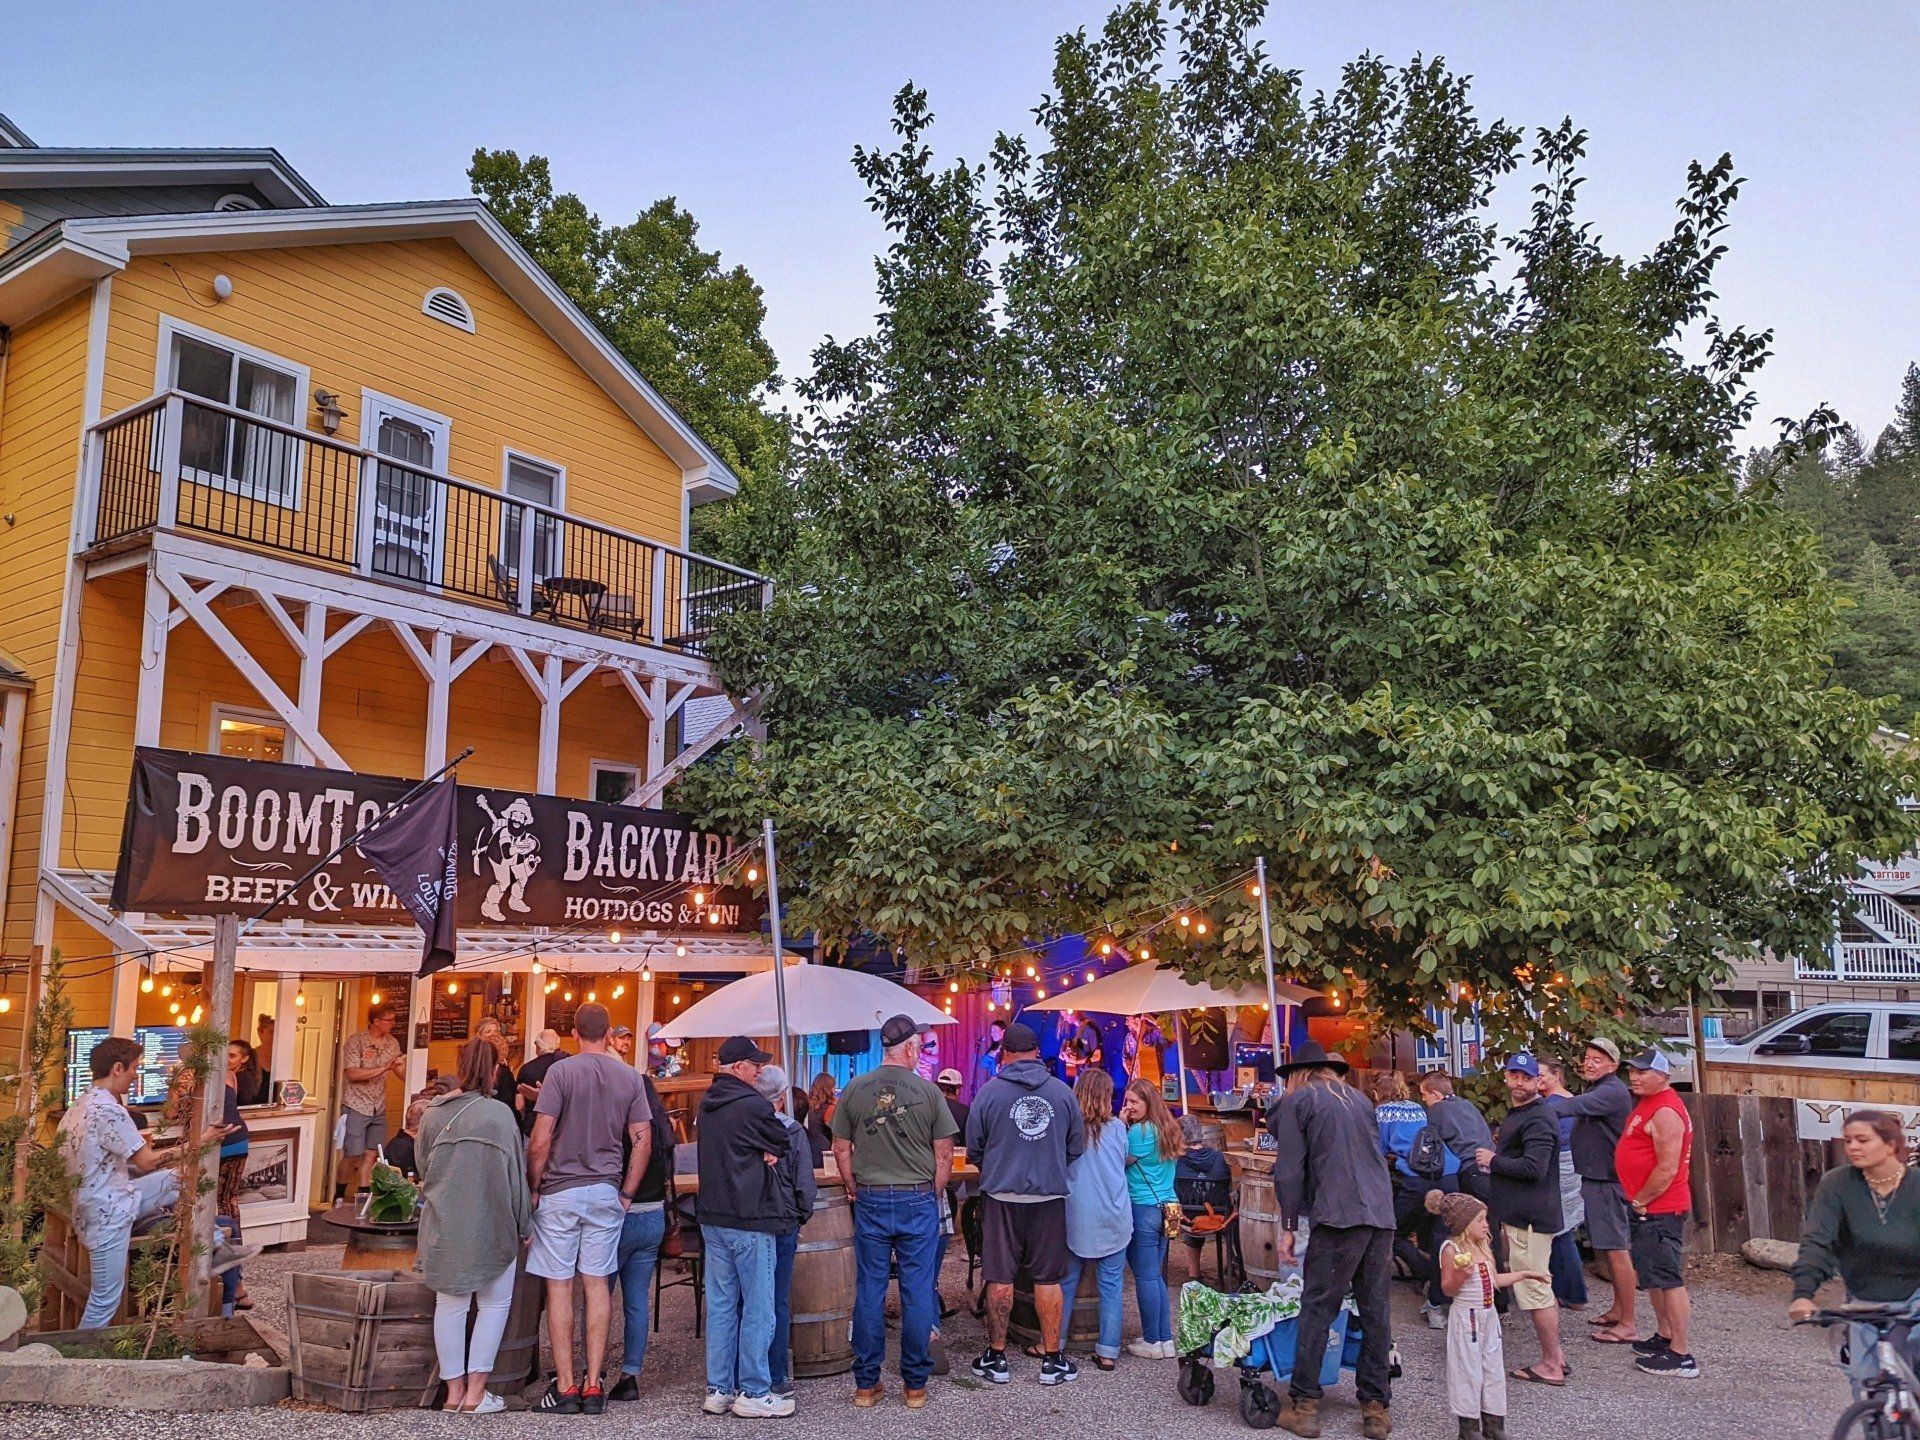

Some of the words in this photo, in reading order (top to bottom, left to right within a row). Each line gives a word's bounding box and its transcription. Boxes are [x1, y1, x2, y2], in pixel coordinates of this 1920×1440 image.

[172, 772, 410, 864] BOOMTO
[204, 875, 299, 906] BEER
[307, 872, 344, 912] &
[417, 873, 440, 913] LOUN
[564, 896, 674, 923] HOTDOGS
[678, 903, 692, 924] &
[694, 903, 740, 926] FUN!
